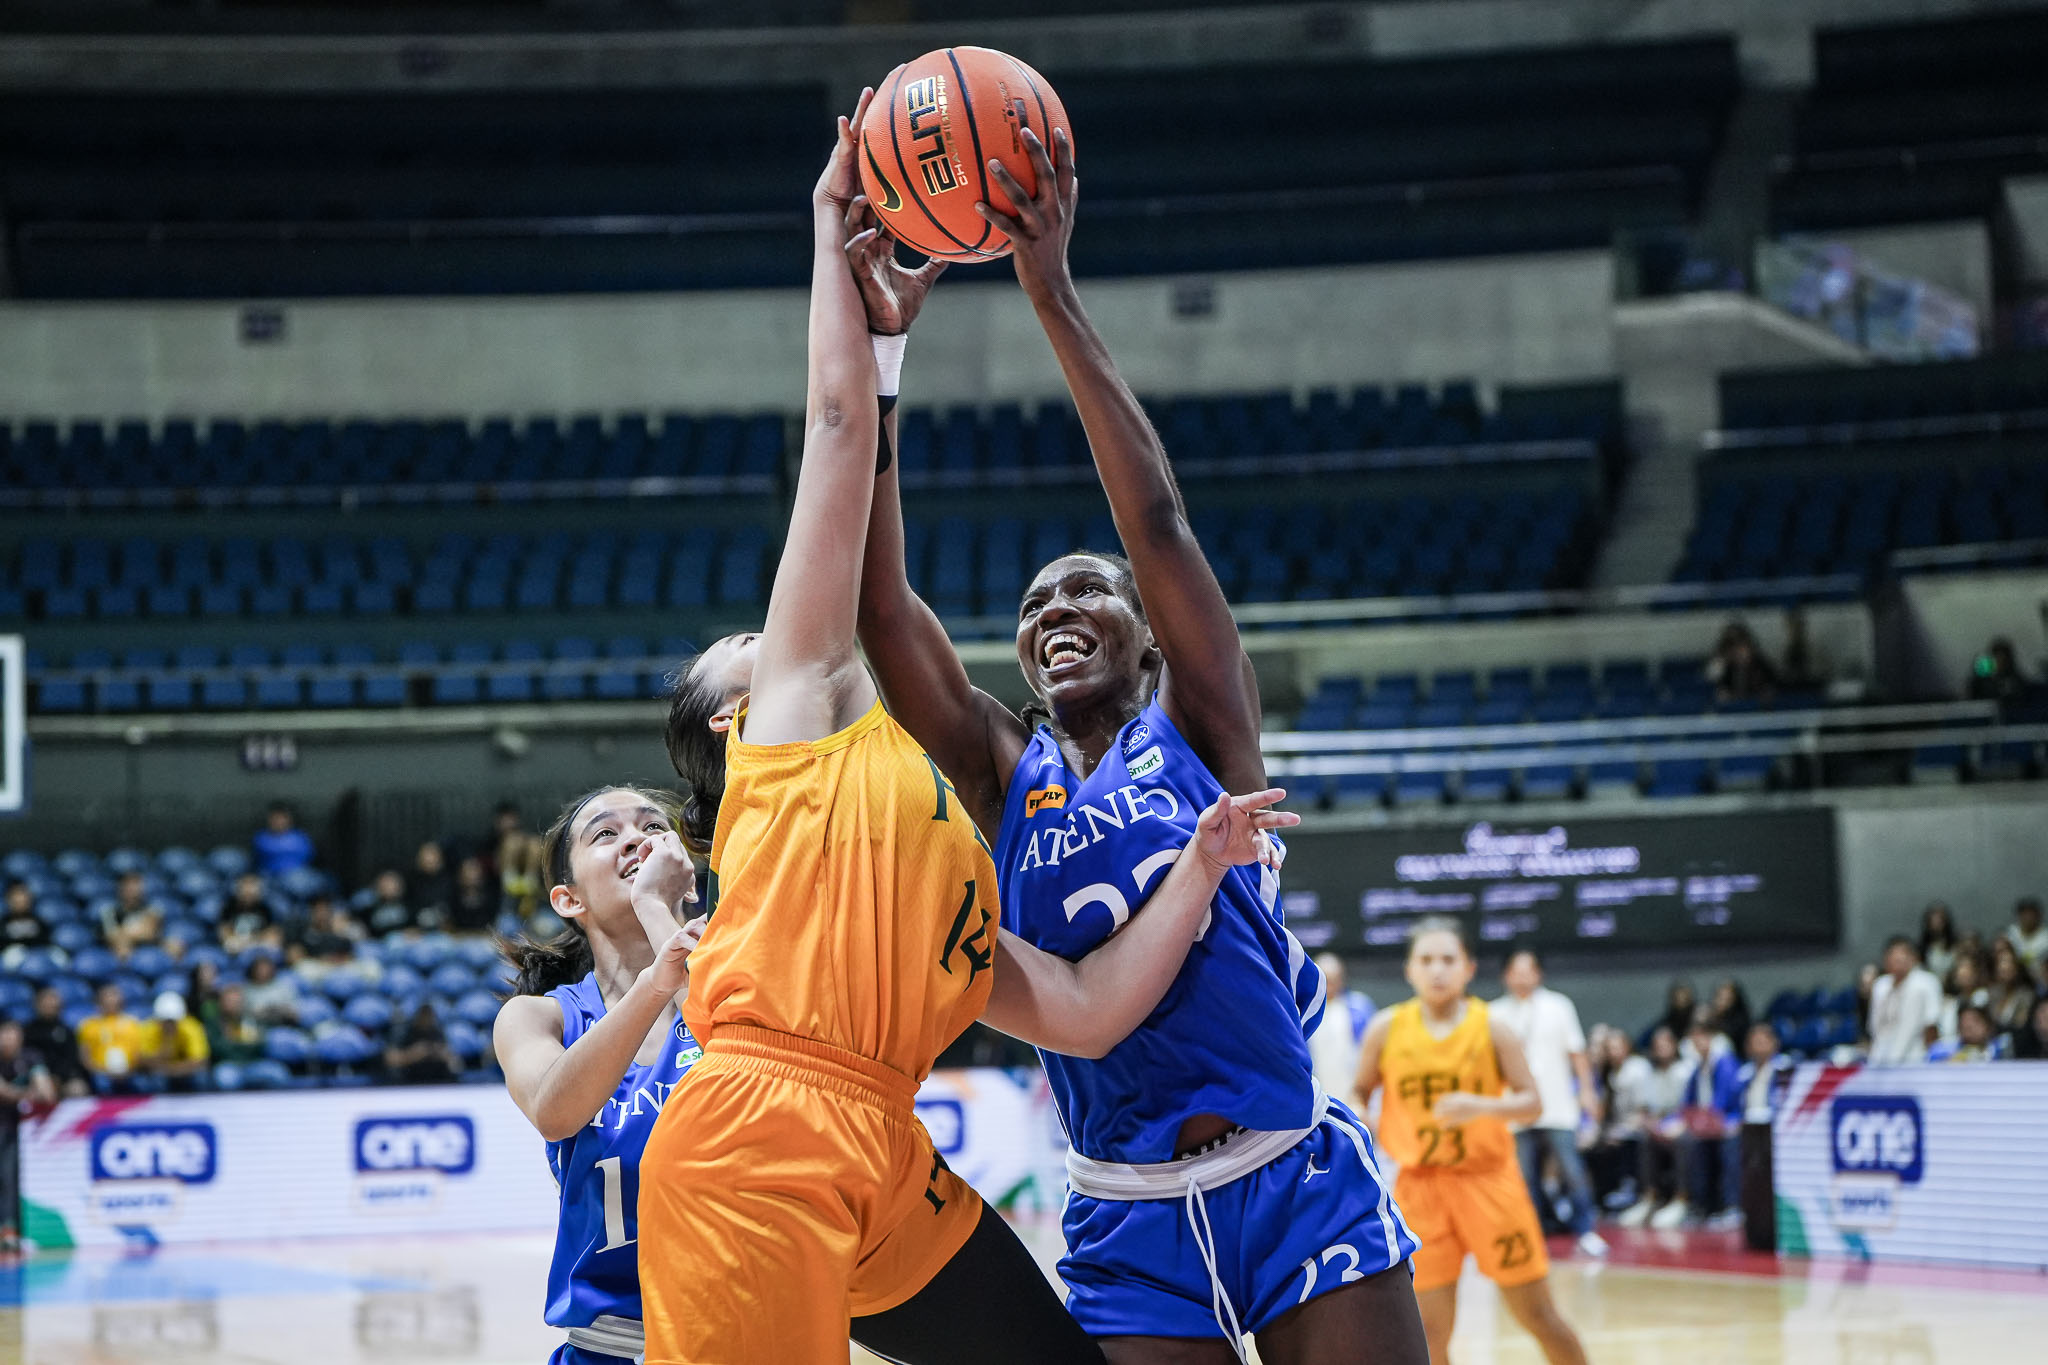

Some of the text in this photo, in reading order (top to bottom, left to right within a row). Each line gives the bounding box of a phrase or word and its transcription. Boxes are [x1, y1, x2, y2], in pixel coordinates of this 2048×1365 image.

[905, 76, 958, 197] ELITE
[936, 75, 969, 187] CHAMPIONSHIP
[1128, 752, 1161, 778] Smart
[1020, 784, 1179, 872] ATENEO
[99, 1130, 211, 1178] one
[361, 1121, 470, 1169] one
[1417, 1123, 1467, 1168] 23
[1836, 1109, 1918, 1170] one
[1493, 1229, 1534, 1269] 23
